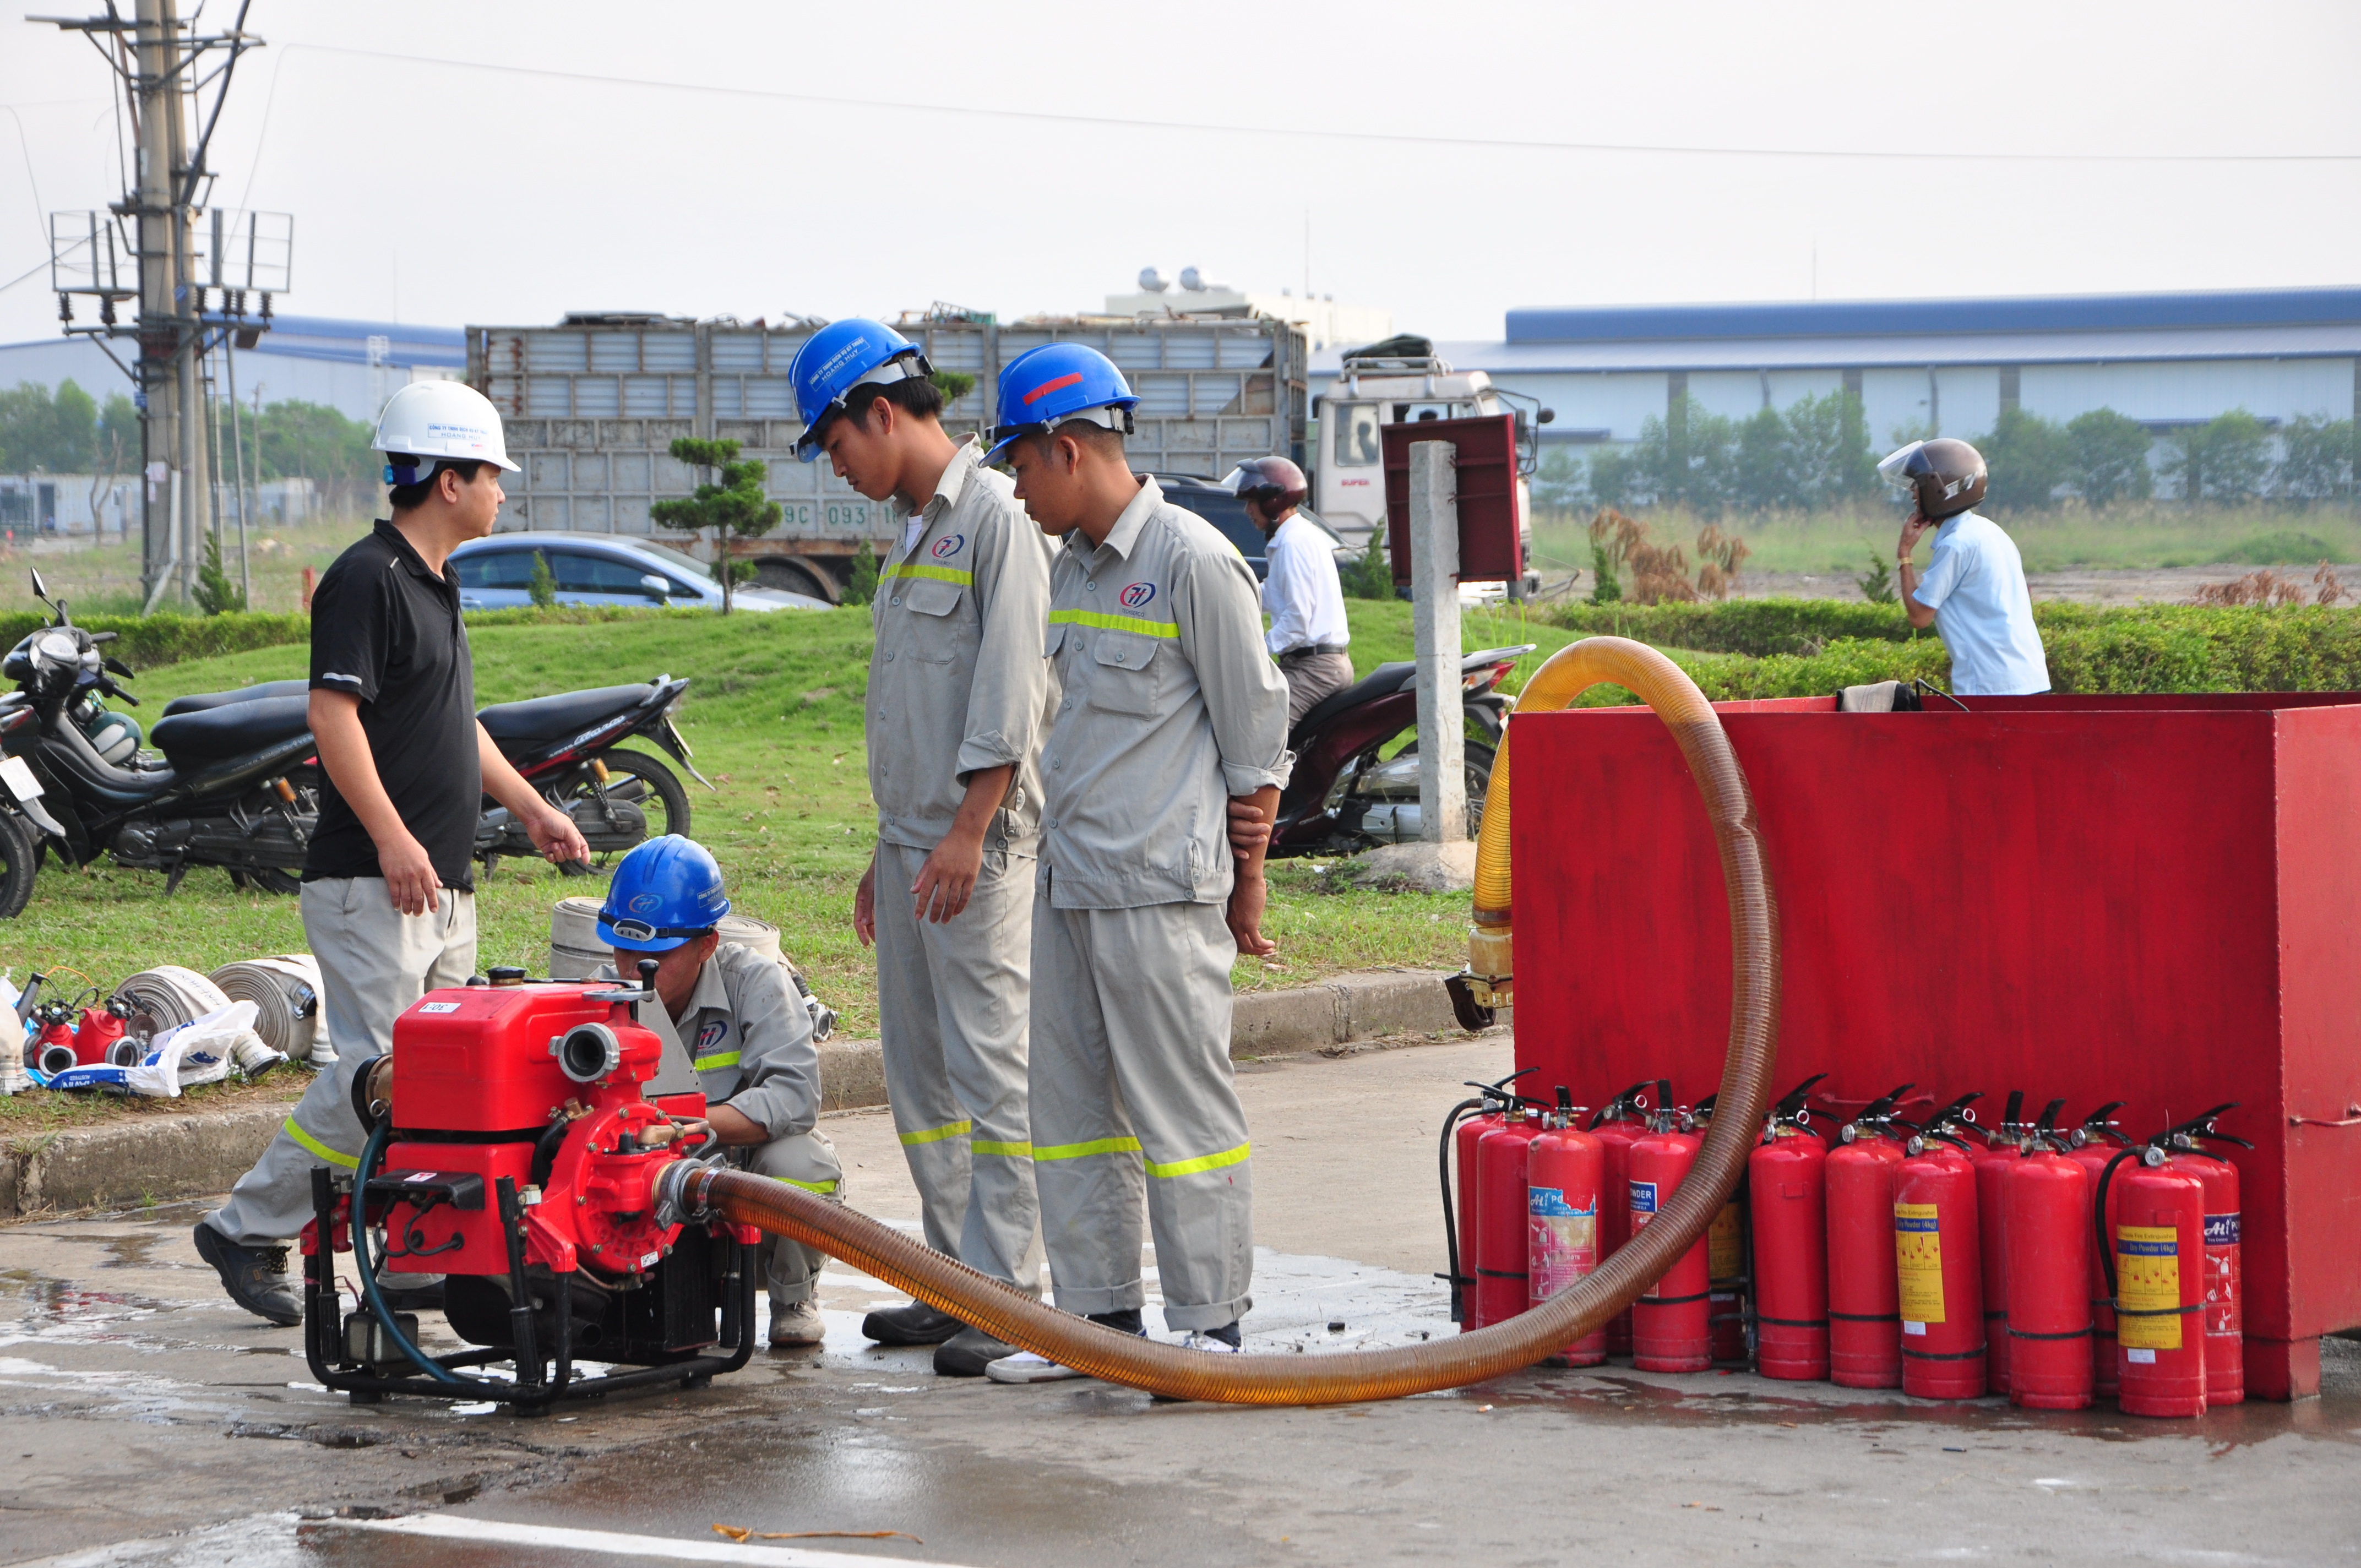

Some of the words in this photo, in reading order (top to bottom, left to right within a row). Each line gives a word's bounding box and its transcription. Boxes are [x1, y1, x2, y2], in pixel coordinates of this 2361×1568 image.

[844, 349, 858, 361] HUY
[784, 505, 808, 524] 9C
[828, 505, 865, 524] 093
[698, 1048, 723, 1056] ECHSERCO
